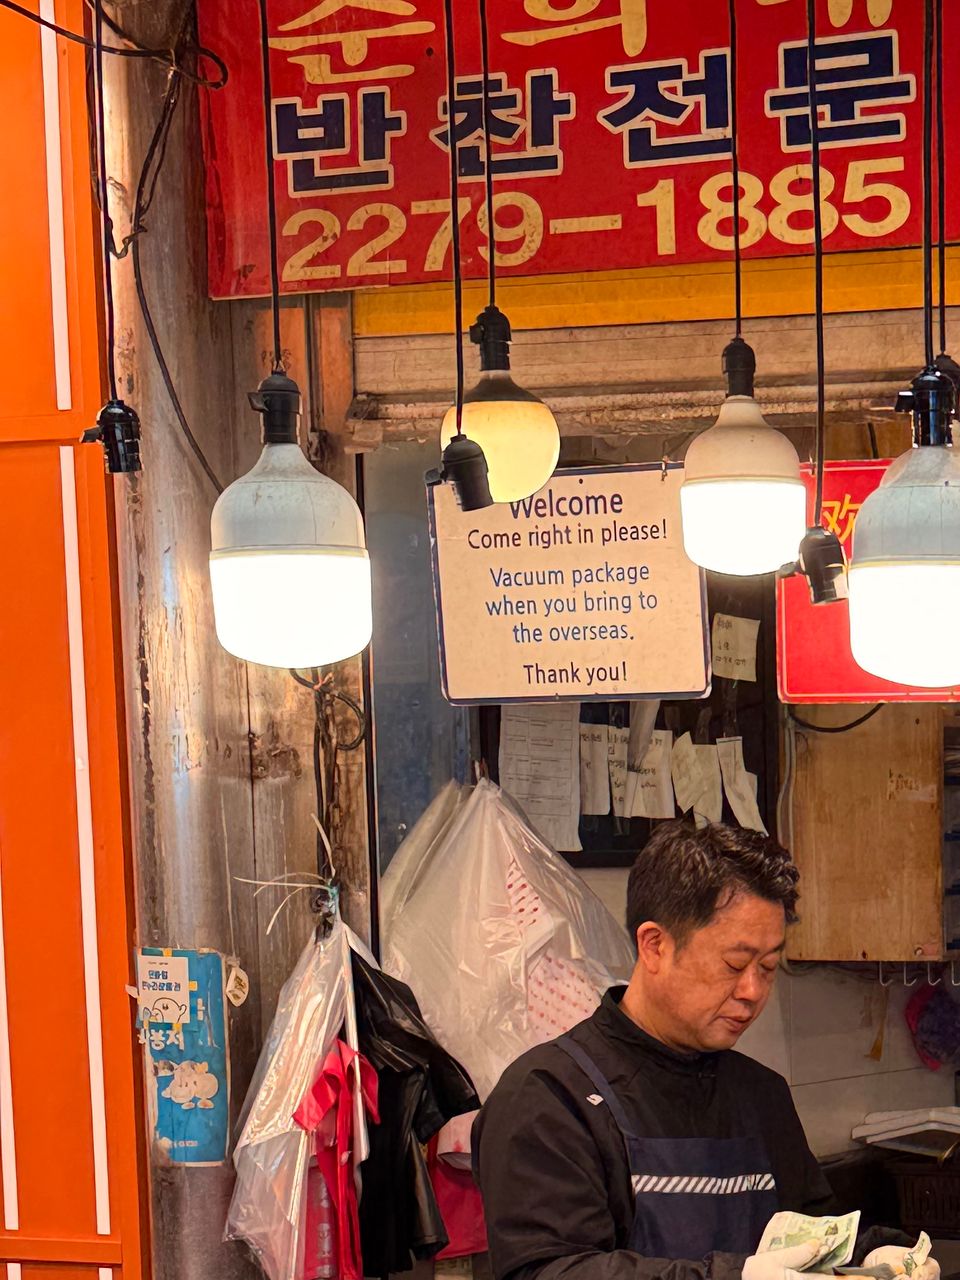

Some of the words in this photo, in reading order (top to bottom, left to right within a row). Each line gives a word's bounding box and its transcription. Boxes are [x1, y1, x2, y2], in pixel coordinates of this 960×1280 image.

[509, 488, 624, 520] Welcome
[468, 528, 522, 550] Come
[528, 524, 572, 550] right
[577, 522, 593, 546] in
[601, 519, 668, 548] please!
[489, 567, 564, 588] Vacuum
[572, 562, 650, 589] package
[485, 594, 538, 616] when
[543, 597, 577, 618] you
[584, 590, 632, 614] bring
[638, 590, 657, 610] to
[512, 621, 543, 644] the
[549, 625, 634, 642] overseas.
[523, 661, 581, 685] Thank
[586, 660, 628, 687] you!
